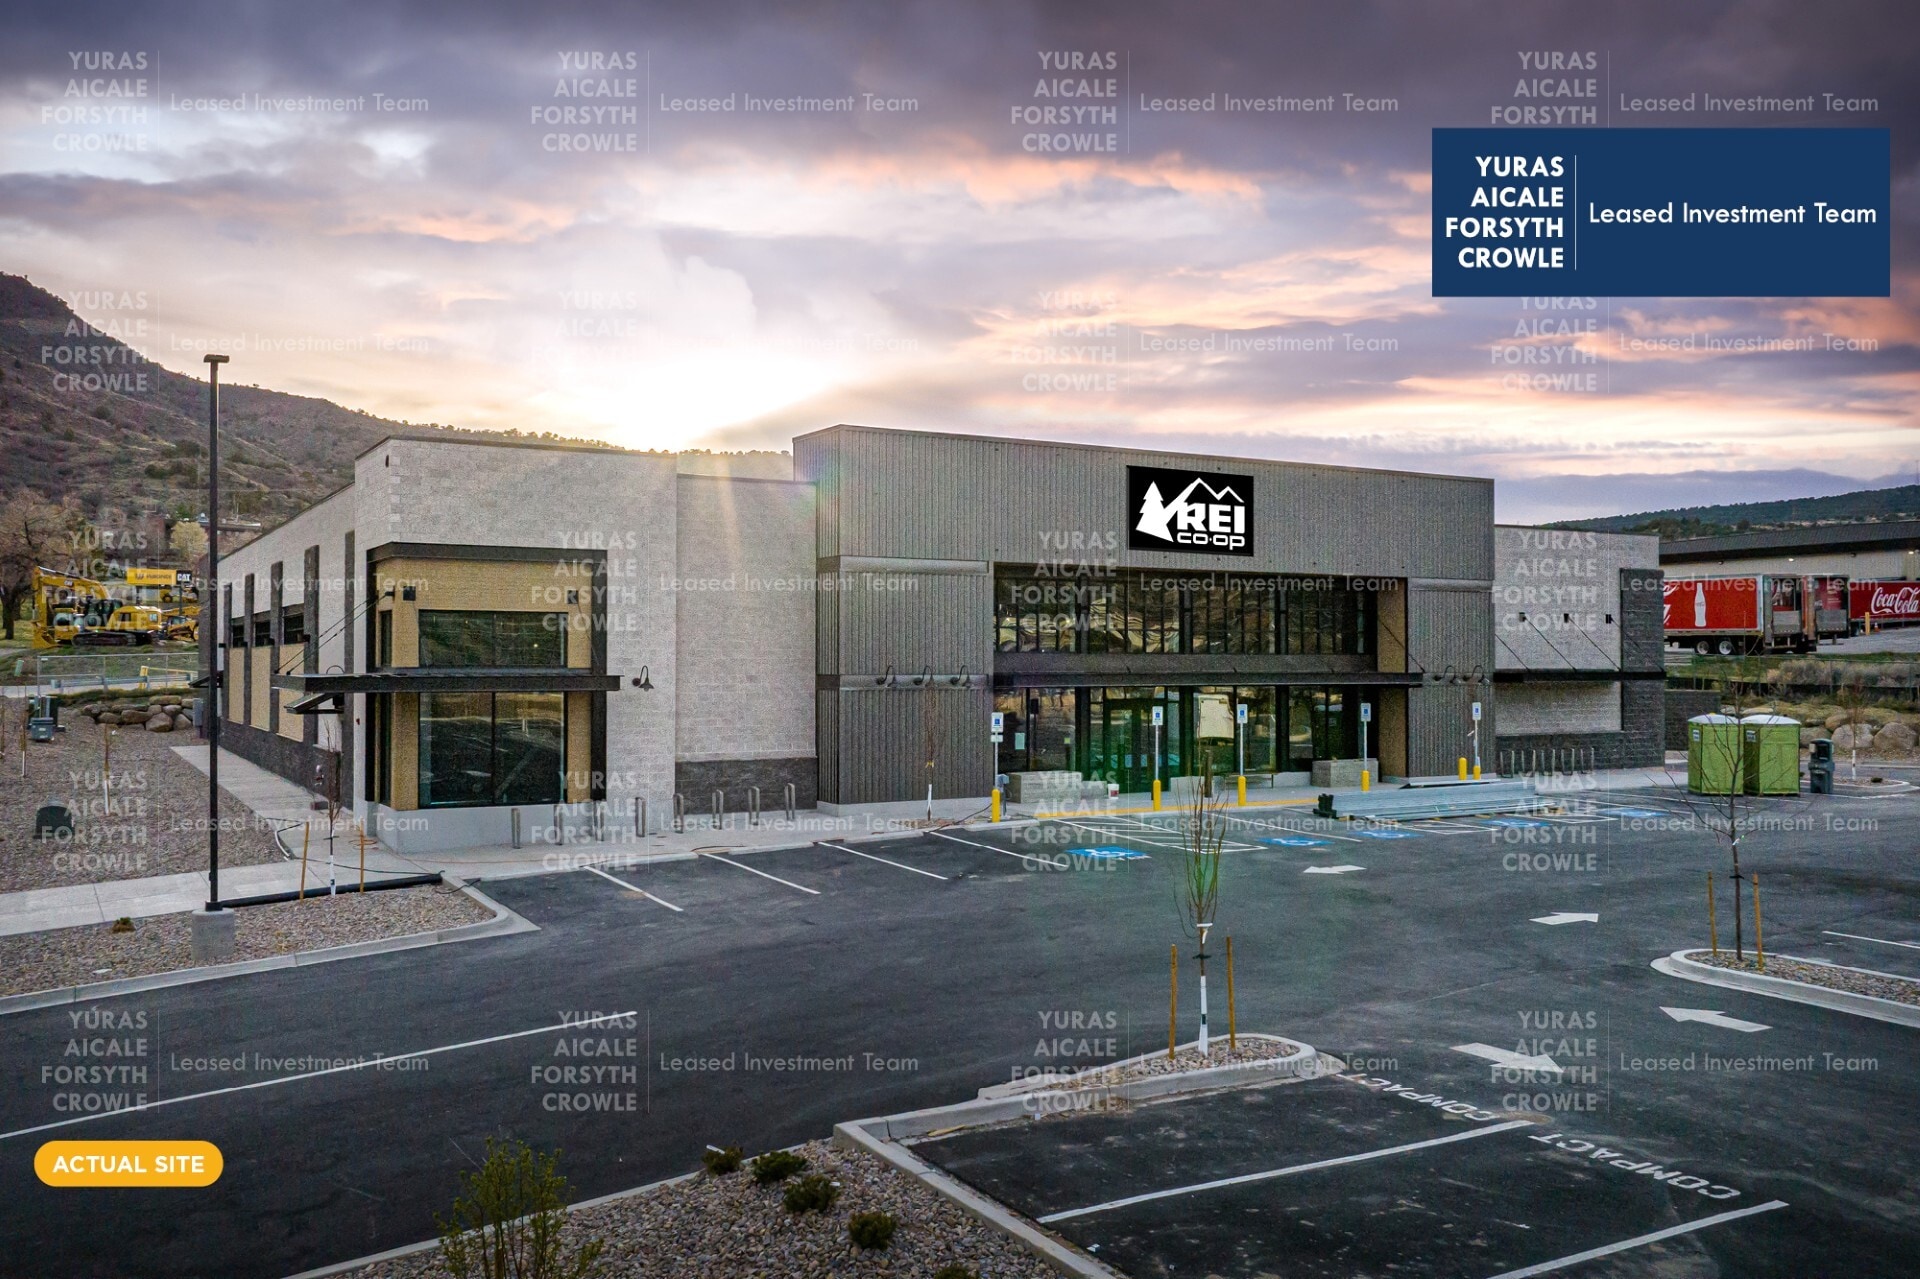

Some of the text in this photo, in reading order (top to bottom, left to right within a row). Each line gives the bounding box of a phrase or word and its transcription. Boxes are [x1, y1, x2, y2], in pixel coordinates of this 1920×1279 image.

[1176, 501, 1245, 534] REI
[177, 573, 191, 582] CAT
[1336, 1073, 1500, 1121] COMPACT
[1528, 1134, 1741, 1199] COMPACT
